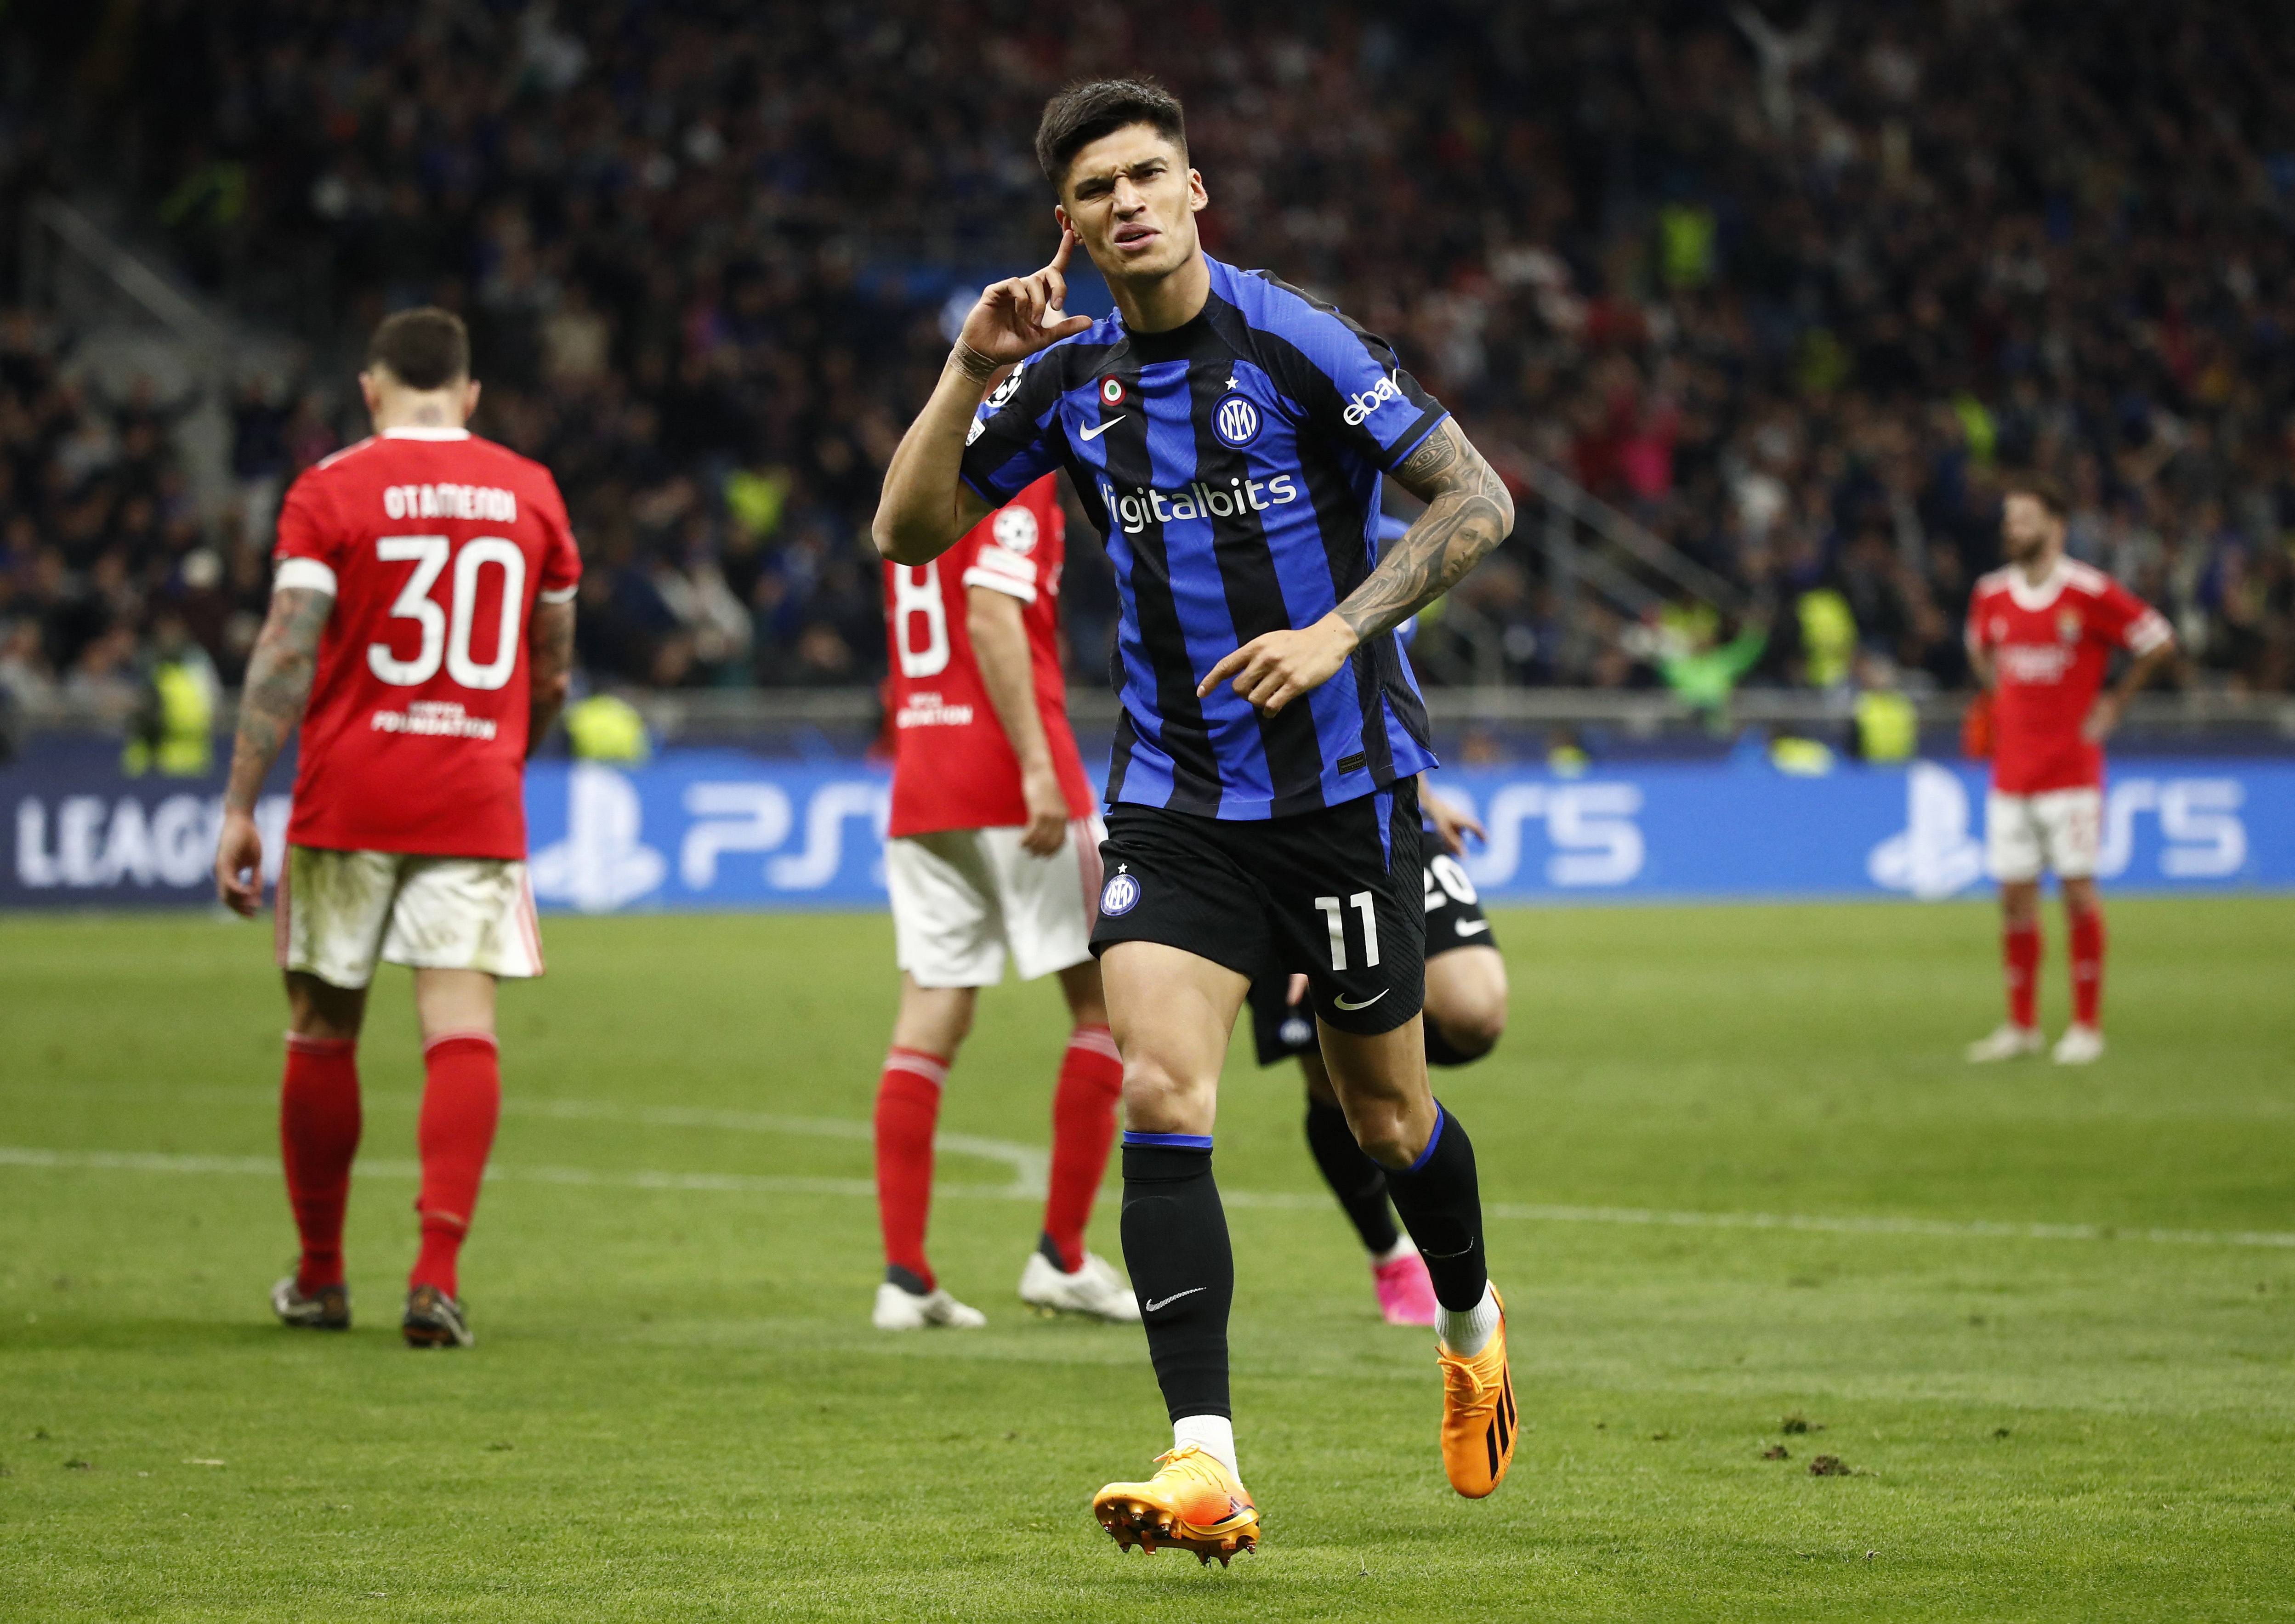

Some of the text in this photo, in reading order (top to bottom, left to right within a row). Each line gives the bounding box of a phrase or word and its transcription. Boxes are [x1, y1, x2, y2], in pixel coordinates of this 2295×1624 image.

[1343, 368, 1402, 426] ebay
[367, 535, 525, 691] 30
[895, 562, 950, 679] 8
[16, 794, 292, 889] LEAG
[681, 782, 889, 891] PS
[1315, 890, 1380, 971] 11
